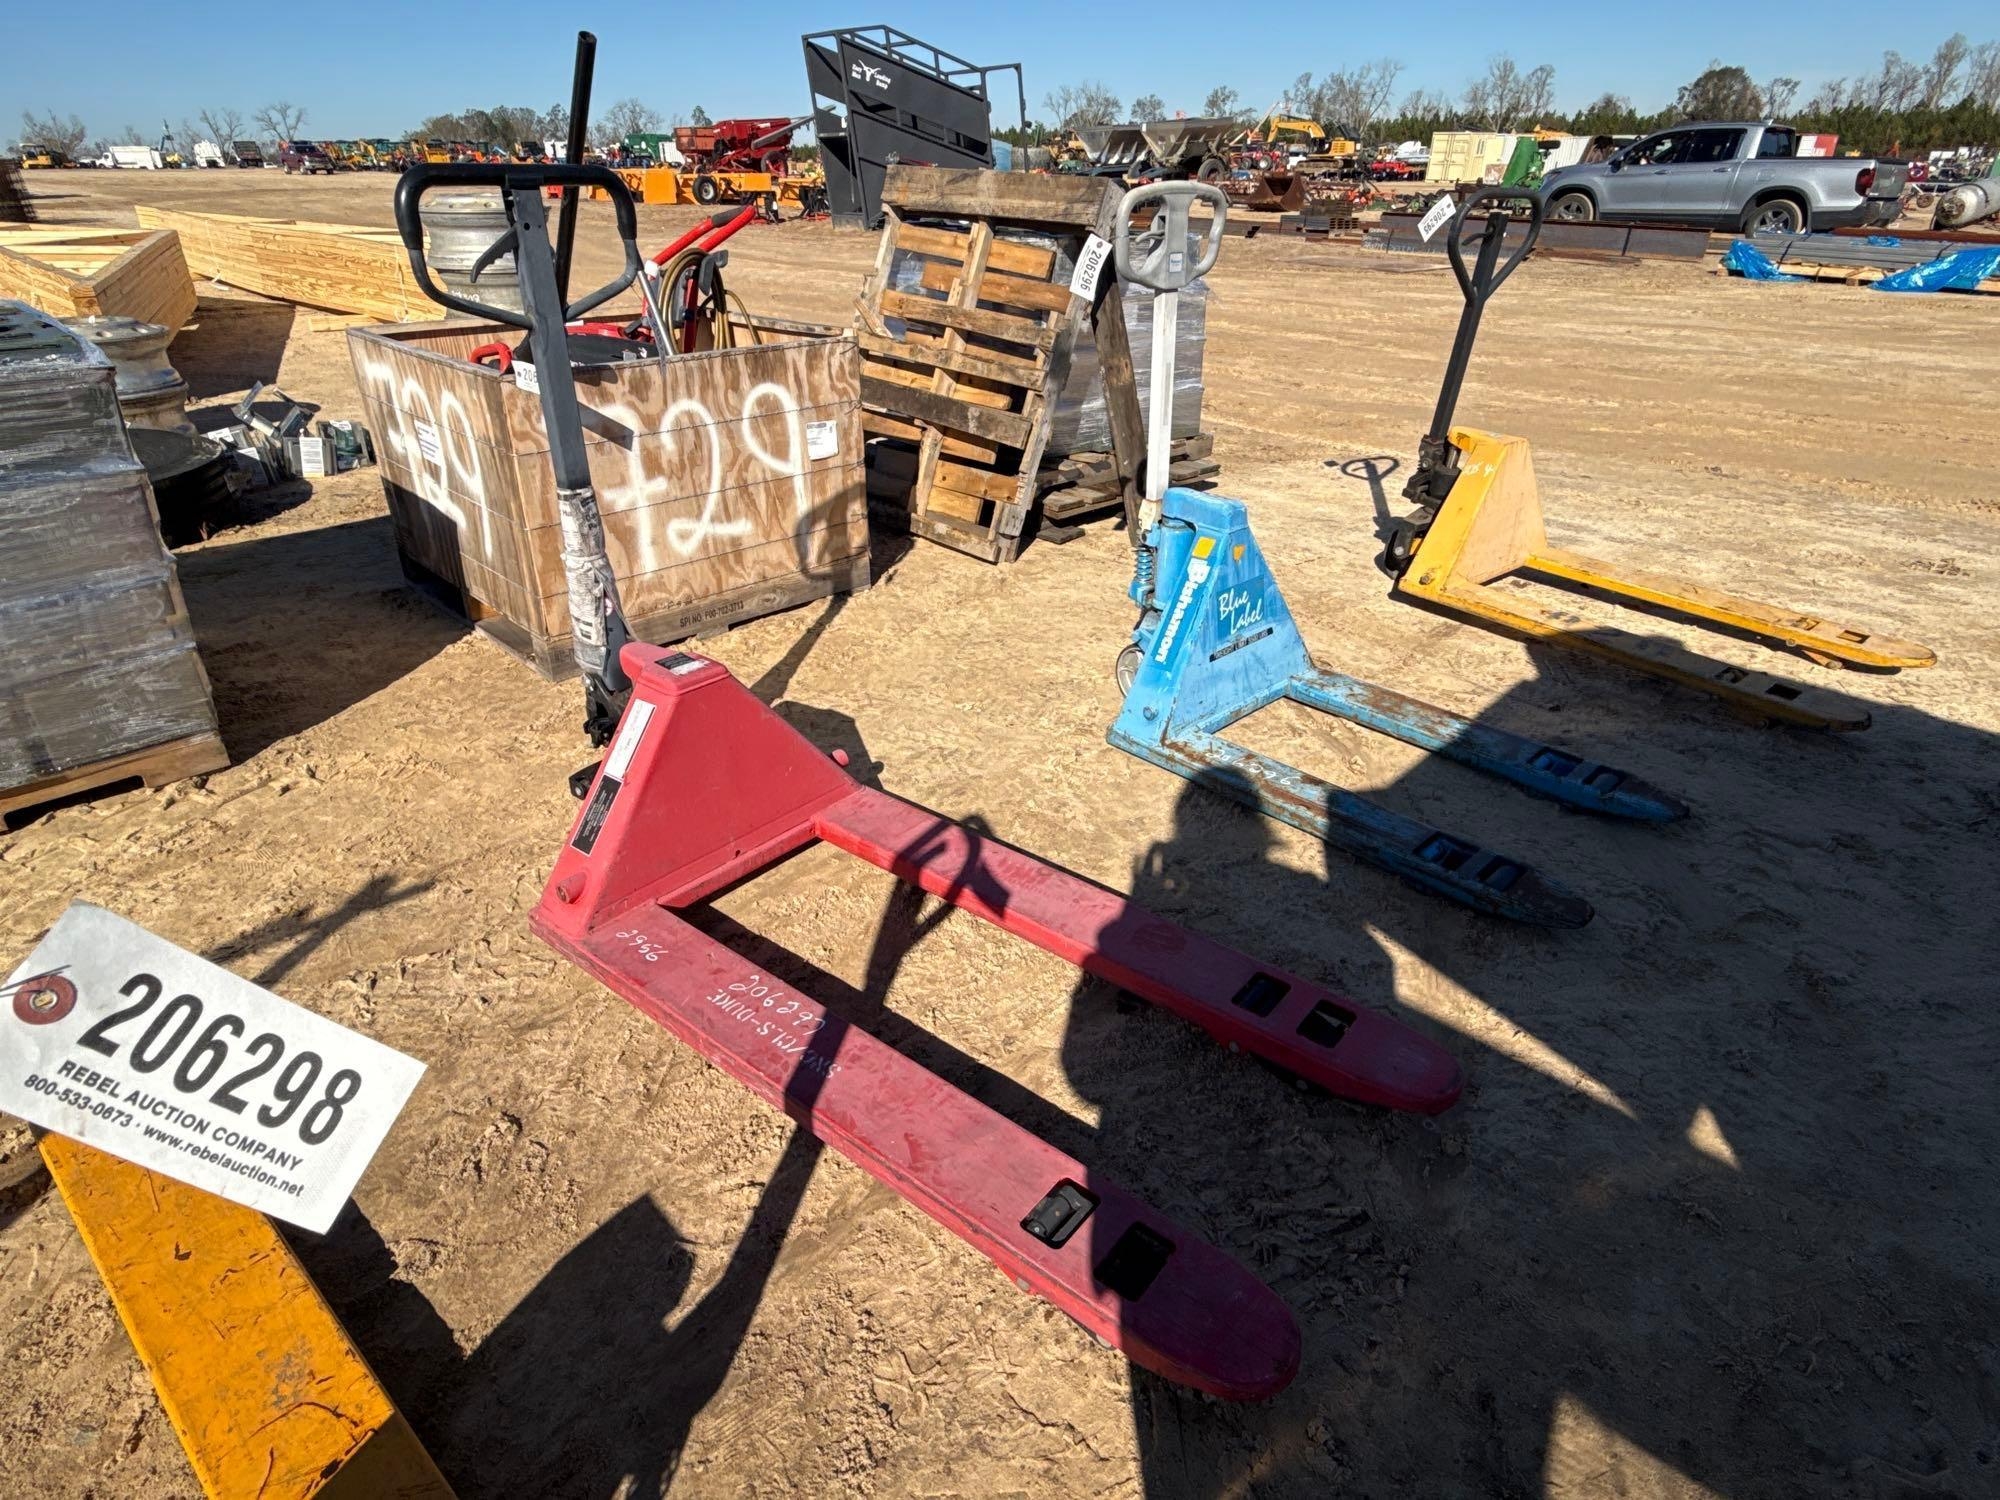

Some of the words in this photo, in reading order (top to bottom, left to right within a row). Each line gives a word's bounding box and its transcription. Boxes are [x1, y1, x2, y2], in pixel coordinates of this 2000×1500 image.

[1081, 250, 1102, 291] 206296
[541, 382, 812, 582] 729
[1219, 588, 1249, 620] Blue
[1231, 598, 1264, 634] Label
[728, 974, 826, 1035] 206297
[77, 972, 362, 1146] 206298
[24, 1073, 134, 1128] 800-533-0673
[142, 1125, 305, 1198] www.rebelauction.net
[58, 1060, 120, 1097] REBEL
[124, 1090, 211, 1135] AUCTION
[211, 1126, 304, 1171] COMPANY
